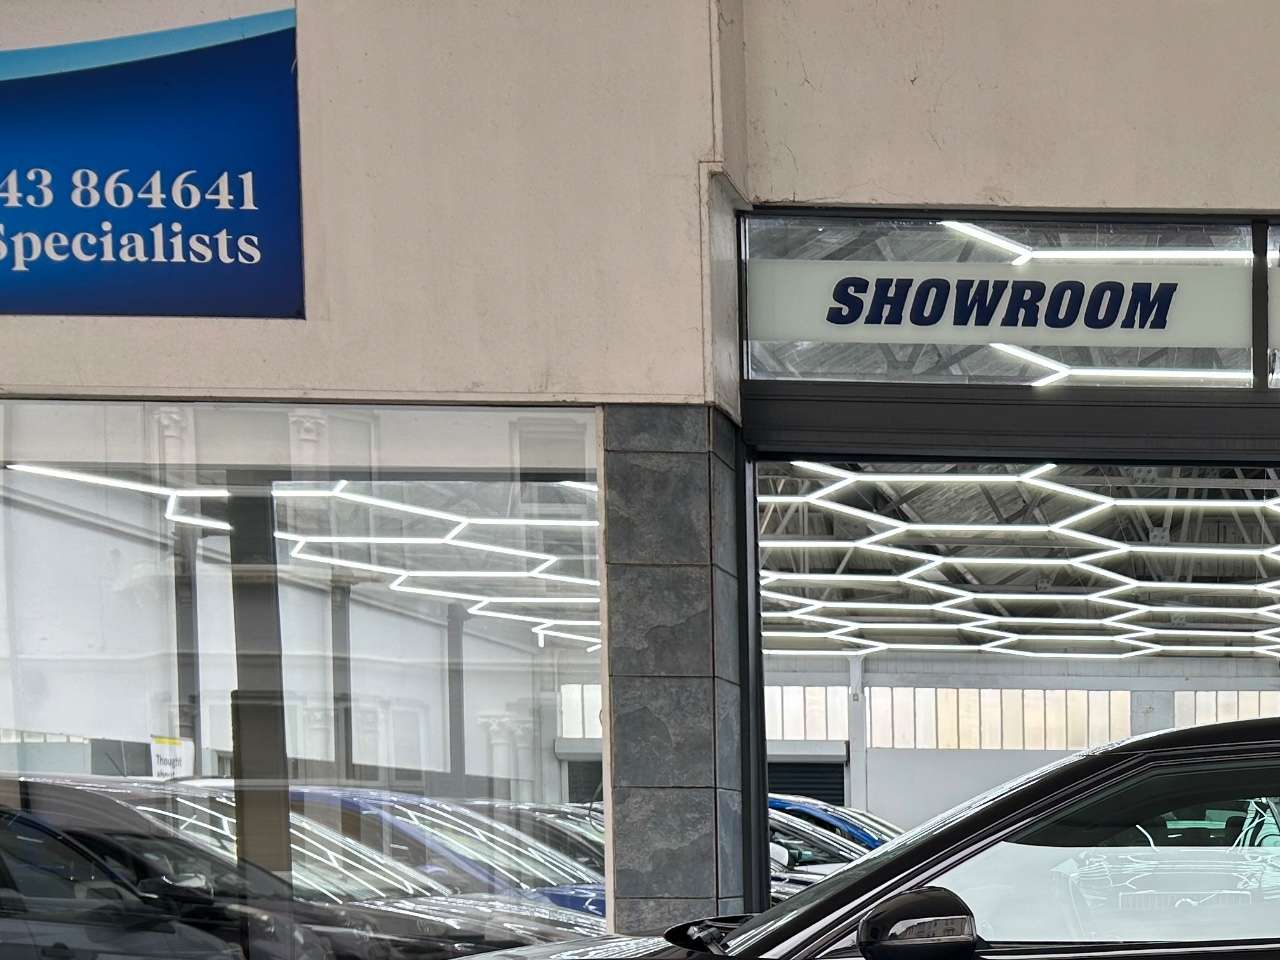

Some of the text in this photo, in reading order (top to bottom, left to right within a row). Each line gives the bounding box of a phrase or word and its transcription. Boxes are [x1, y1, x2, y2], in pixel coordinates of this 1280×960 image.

[0, 168, 259, 211] 43 864641
[825, 276, 1179, 330] SHOWROOM
